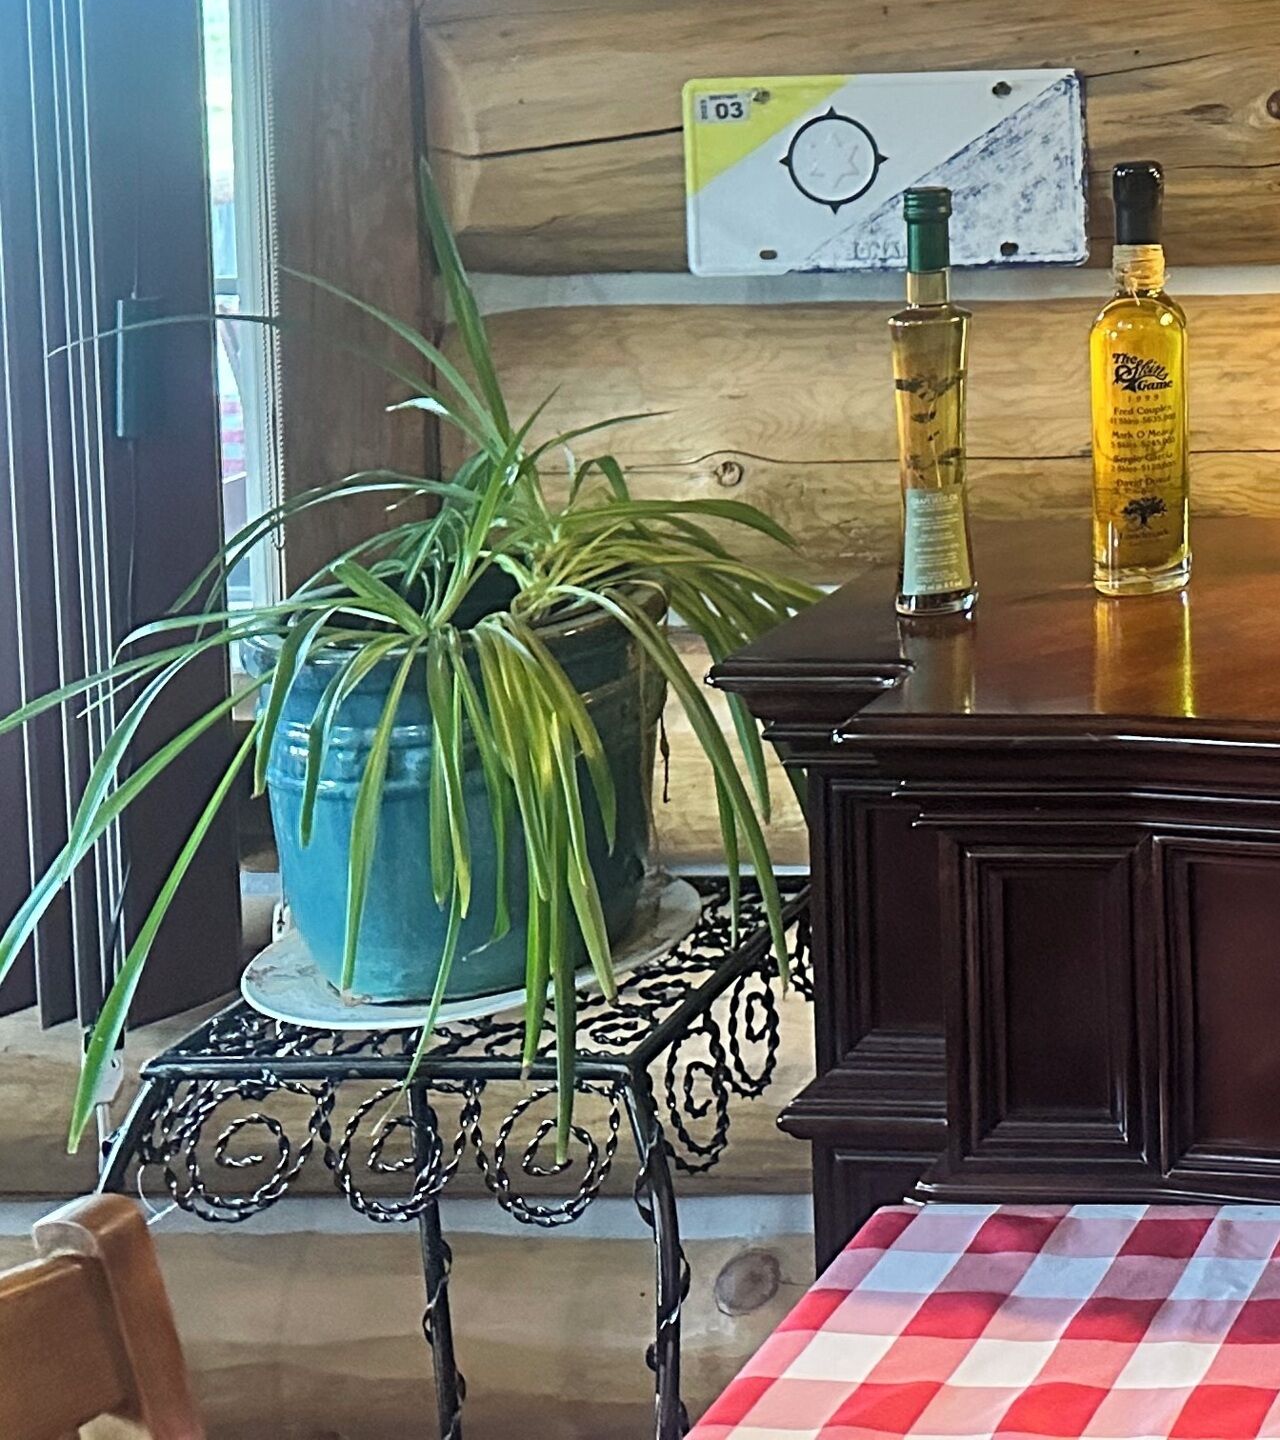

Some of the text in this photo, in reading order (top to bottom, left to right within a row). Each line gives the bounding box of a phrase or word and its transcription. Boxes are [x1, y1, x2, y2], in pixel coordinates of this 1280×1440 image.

[715, 101, 744, 119] 03
[1112, 352, 1139, 365] The
[1136, 379, 1174, 392] Game
